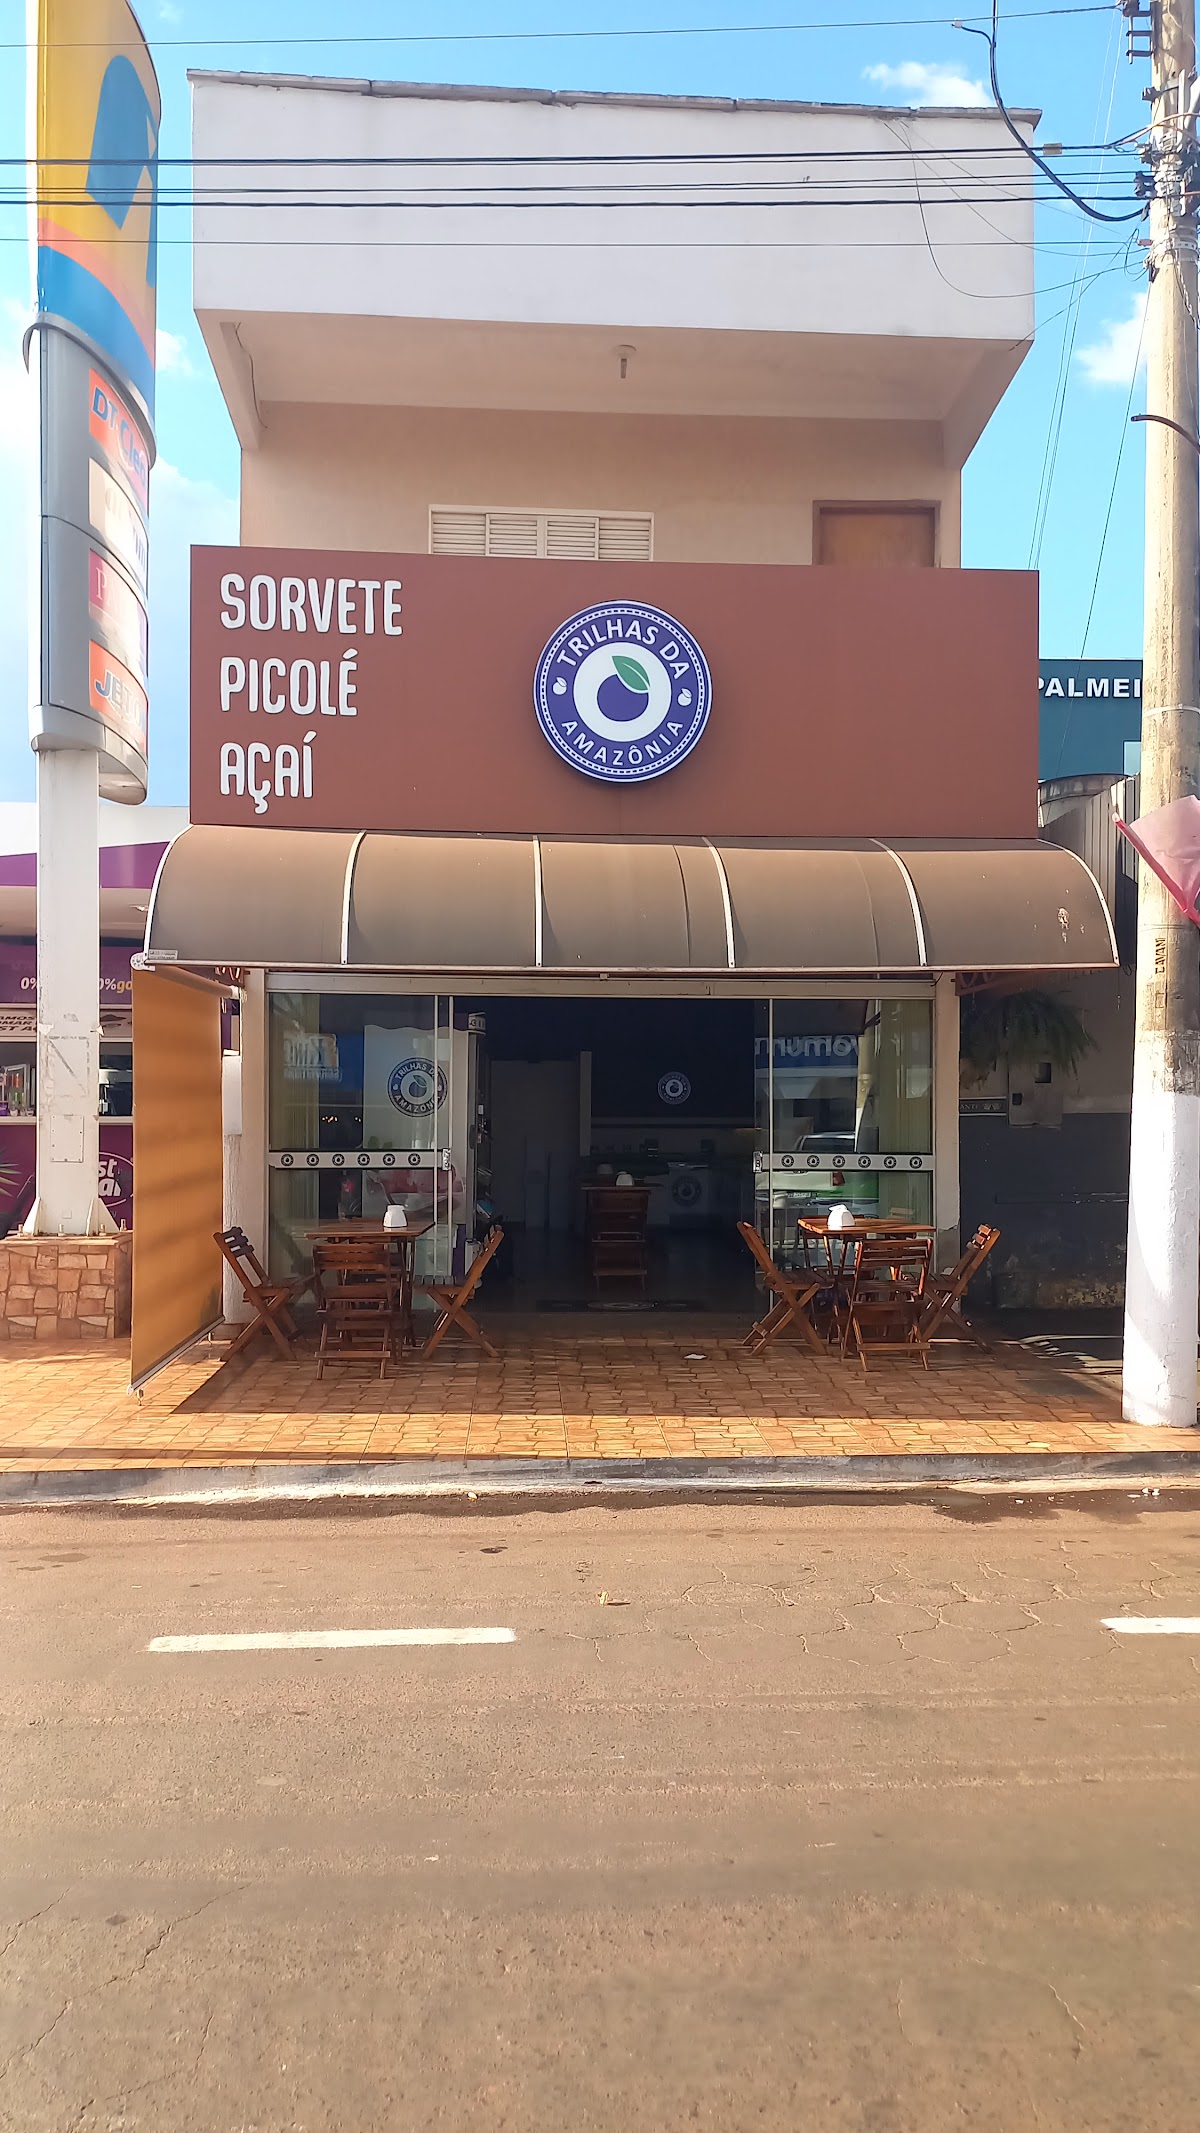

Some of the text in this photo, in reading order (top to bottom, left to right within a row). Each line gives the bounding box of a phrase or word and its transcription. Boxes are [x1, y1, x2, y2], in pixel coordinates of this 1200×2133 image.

[220, 573, 402, 635] SORVETE
[556, 618, 690, 679] TRILHAS DA
[220, 648, 358, 716] PICOLÉ
[220, 730, 317, 814] AÇAÍ
[561, 720, 683, 766] AMAZÔNIA
[394, 1062, 428, 1080] TRILHAS
